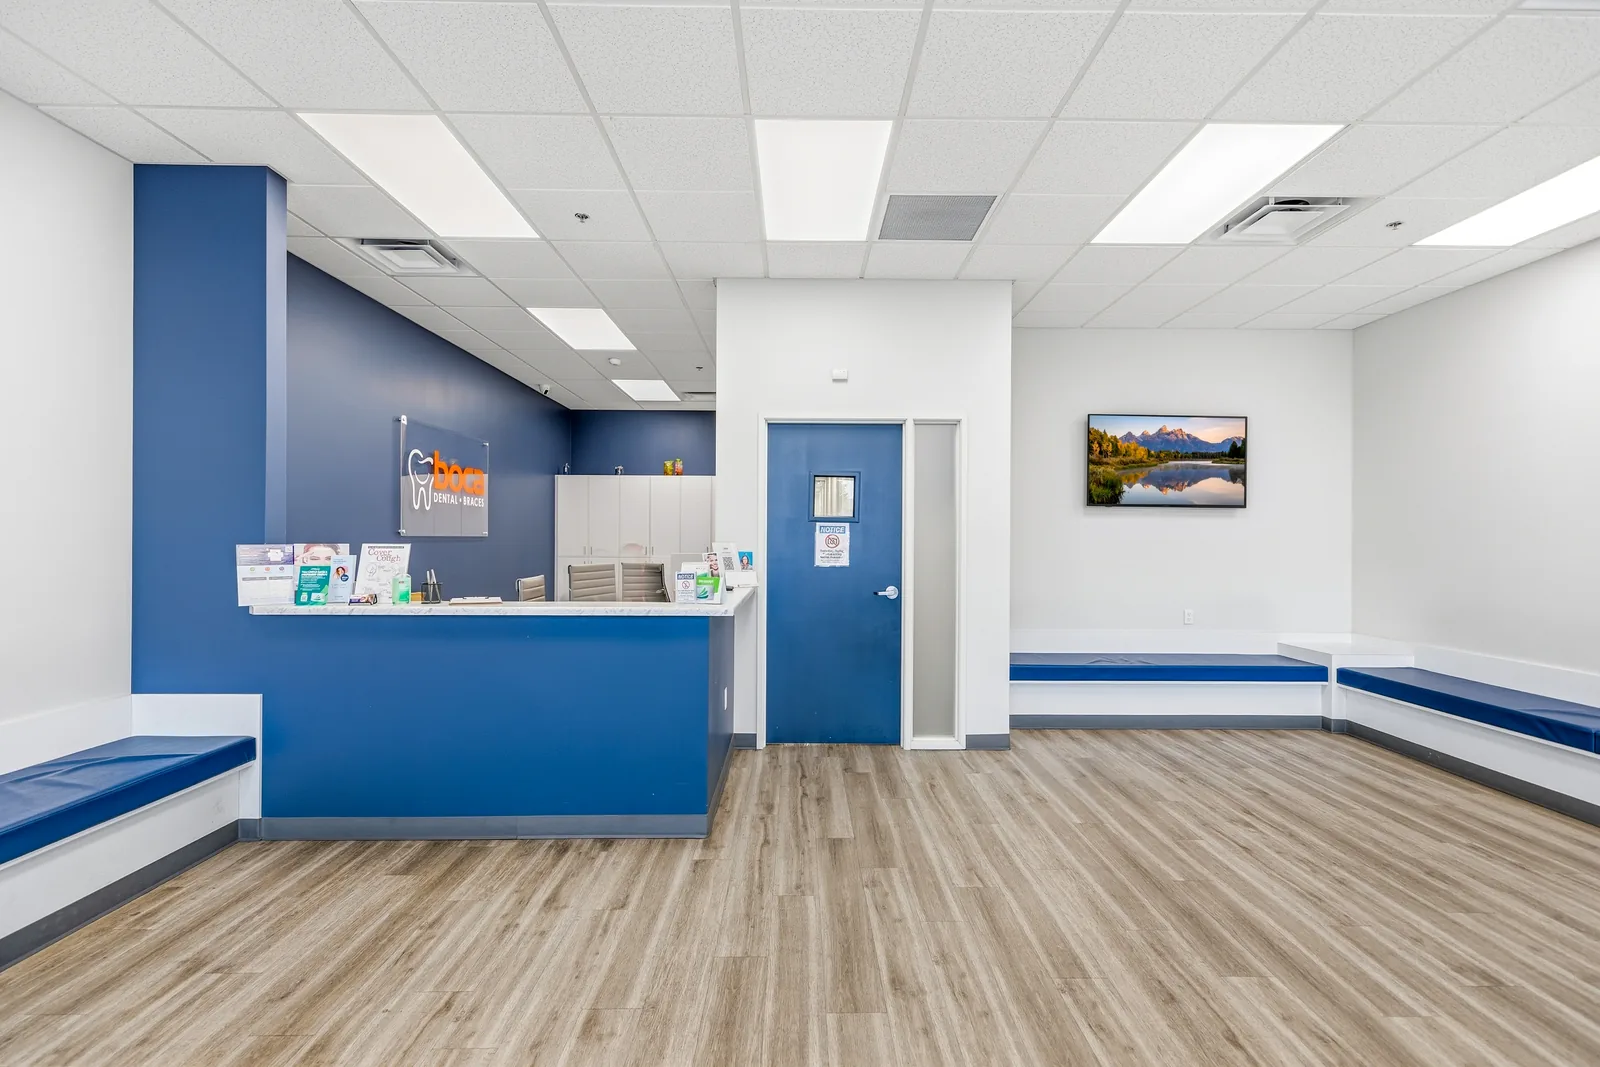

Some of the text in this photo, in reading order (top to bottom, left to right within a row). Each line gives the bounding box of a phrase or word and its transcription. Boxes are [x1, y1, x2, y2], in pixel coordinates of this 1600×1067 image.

[434, 449, 485, 496] boca
[433, 492, 485, 507] DENTAL BRACES
[367, 548, 393, 556] Cover
